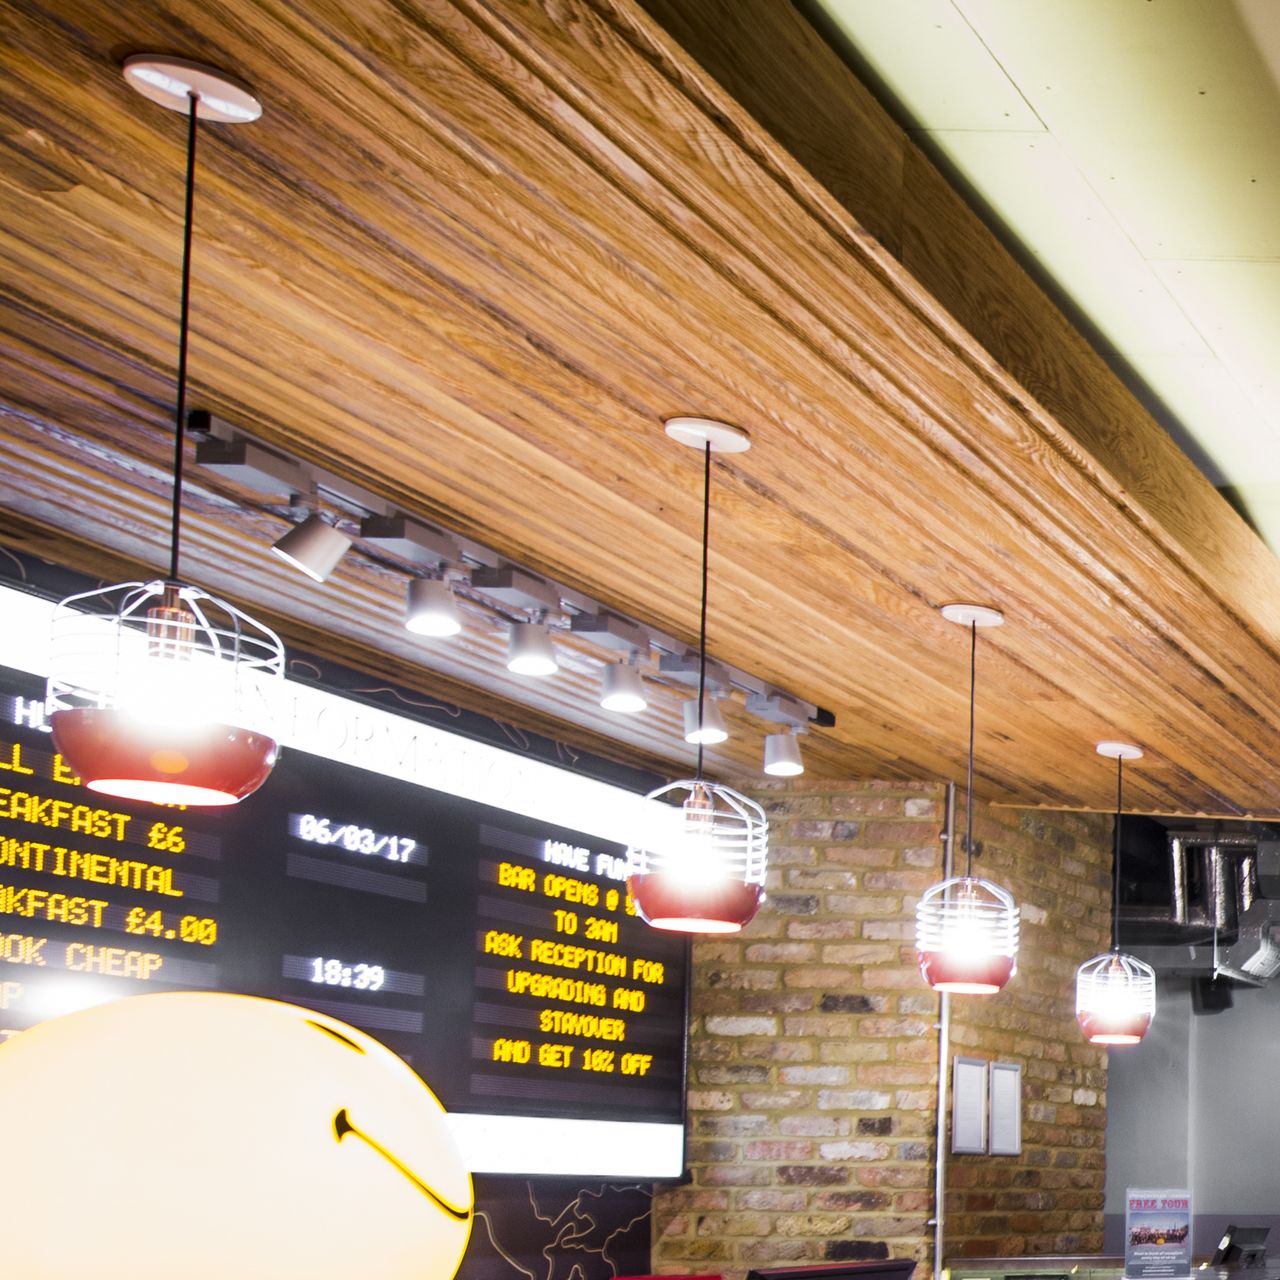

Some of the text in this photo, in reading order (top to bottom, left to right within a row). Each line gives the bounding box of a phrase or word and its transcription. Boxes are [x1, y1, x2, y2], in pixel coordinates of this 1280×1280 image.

[147, 822, 186, 854] £6
[299, 814, 416, 863] 06/03/17
[543, 839, 591, 872] HAVE
[498, 862, 536, 893] BAR
[543, 873, 600, 908] OPENS
[126, 906, 218, 946] £4.00
[554, 909, 578, 936] TO
[64, 942, 164, 980] CHEAP
[310, 956, 385, 991] 18:39
[484, 930, 665, 985] ASK RECEPTION FOR
[507, 969, 646, 1013] UPGRADING AND
[539, 1009, 626, 1042] STAYOVER
[493, 1038, 653, 1077] AND GET 10% OFF
[1129, 1199, 1189, 1211] FREE TOUR
